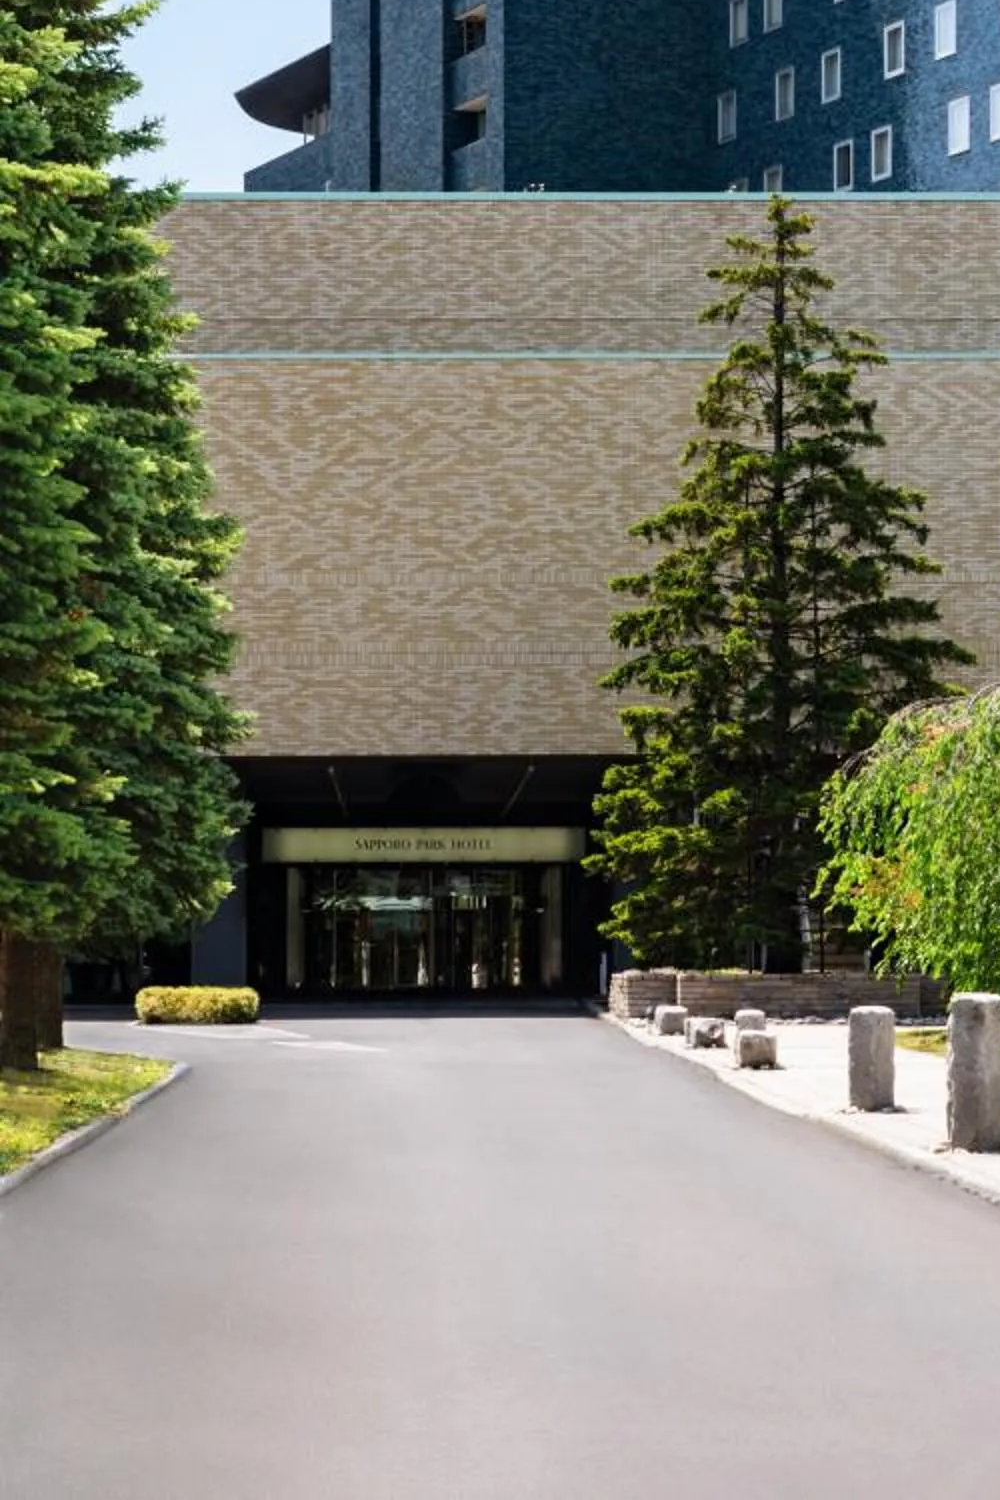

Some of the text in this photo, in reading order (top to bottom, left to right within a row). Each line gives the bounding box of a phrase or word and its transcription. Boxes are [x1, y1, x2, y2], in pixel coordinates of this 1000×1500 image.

[354, 839, 491, 850] SAPPORO PARK HOTEL
